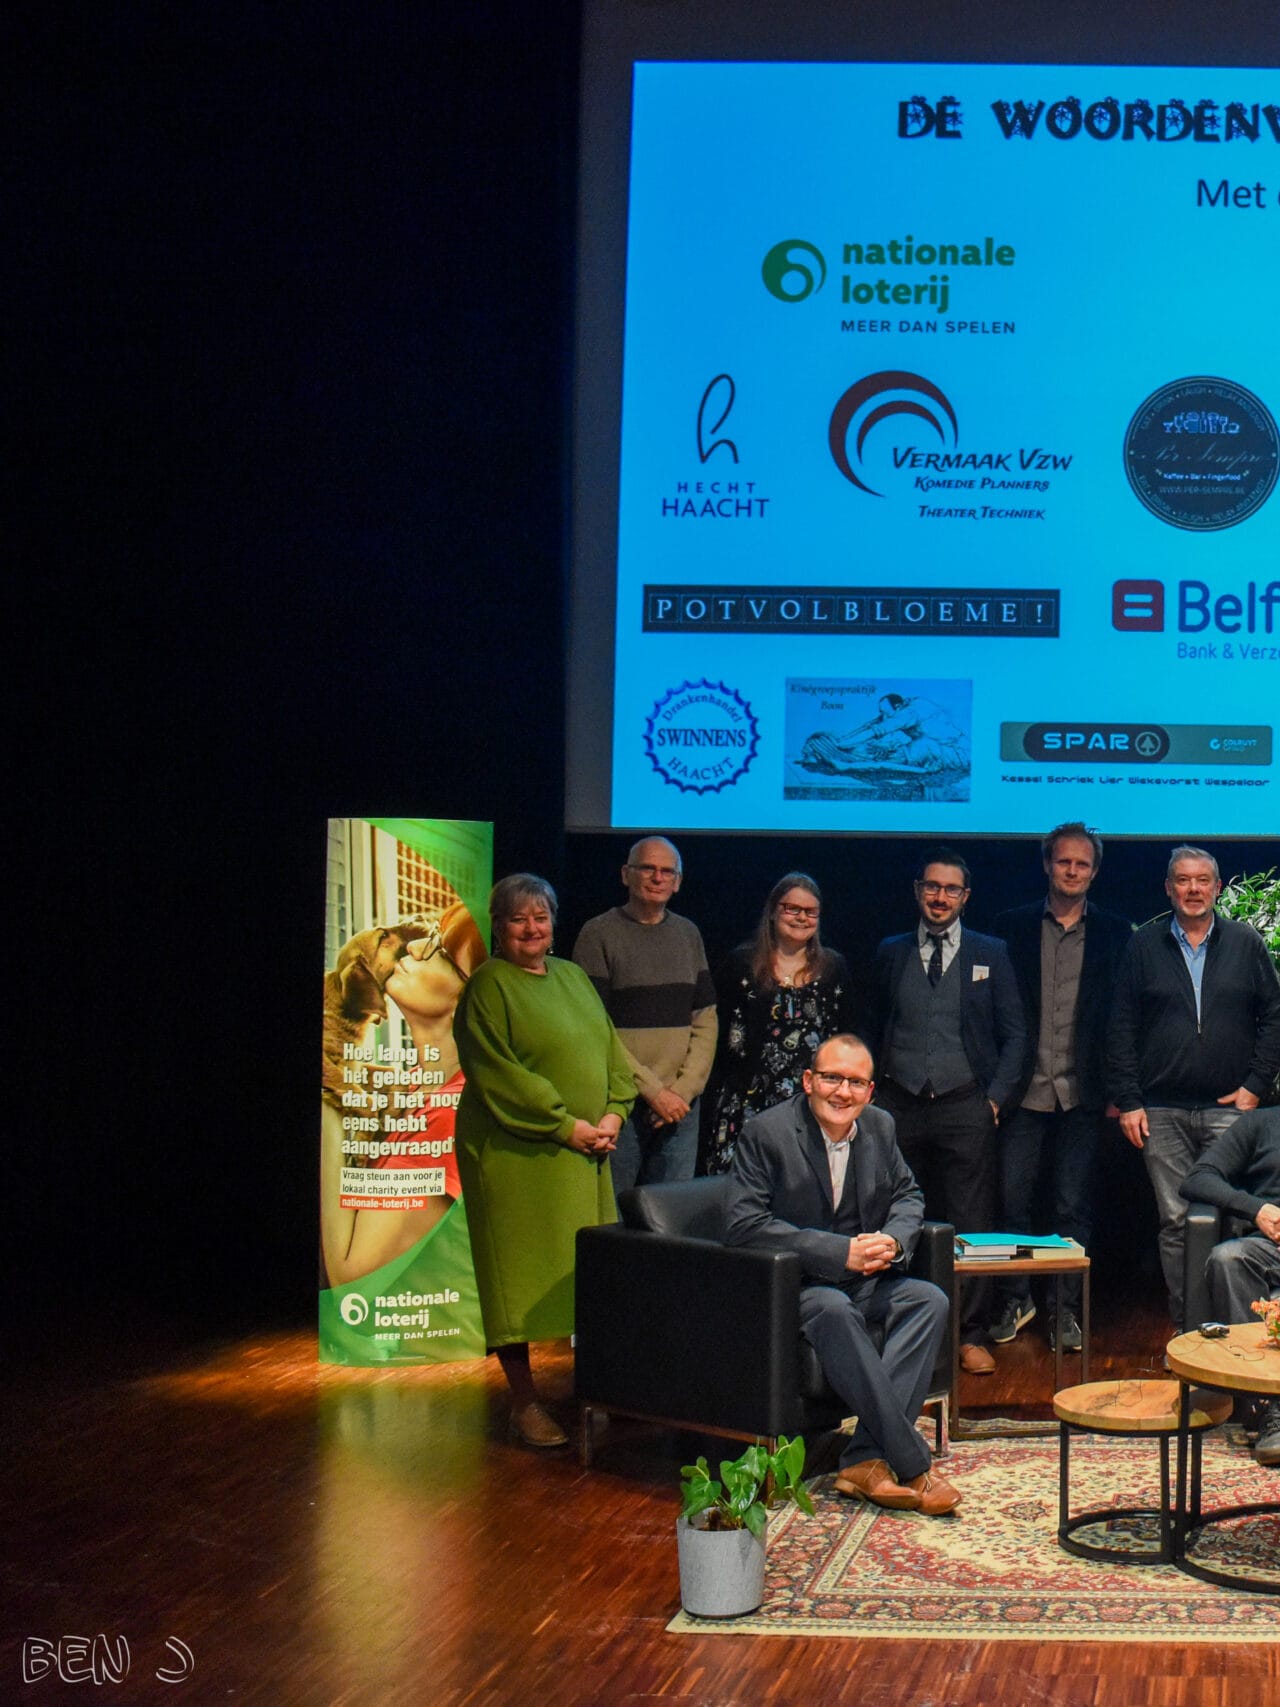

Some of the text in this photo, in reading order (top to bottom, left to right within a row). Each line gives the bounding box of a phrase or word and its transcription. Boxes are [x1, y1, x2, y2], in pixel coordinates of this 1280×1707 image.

[898, 95, 963, 139] DE
[1196, 180, 1266, 209] Met
[842, 236, 1016, 266] nationale
[841, 275, 949, 313] loterij
[841, 320, 1016, 334] MEER DAN SPELEN
[677, 482, 757, 495] HECHT
[661, 498, 769, 518] HAACHT
[1177, 642, 1217, 659] Bank
[1222, 643, 1234, 659] &
[662, 694, 742, 723] Drankenhandel
[657, 728, 747, 747] SWINNENS
[1043, 732, 1129, 750] SPAR
[668, 757, 735, 780] HAACHT
[1002, 775, 1270, 787] Kessel Schriek Lier Wiekevorst Wespelaar
[343, 1043, 440, 1065] Hoe lang is
[343, 1067, 445, 1088] het geleden
[342, 1090, 368, 1107] dat
[369, 1091, 388, 1111] je
[394, 1092, 425, 1108] het
[342, 1114, 427, 1132] eens hebt
[343, 1169, 442, 1182] Vraag steun aan voor je
[343, 1184, 442, 1195] lokaal charity event via
[342, 1198, 424, 1210] nationale-loterij.be
[375, 1288, 460, 1307] nationale
[375, 1309, 430, 1329] loterij
[375, 1328, 460, 1341] MEER DAN SPELEN
